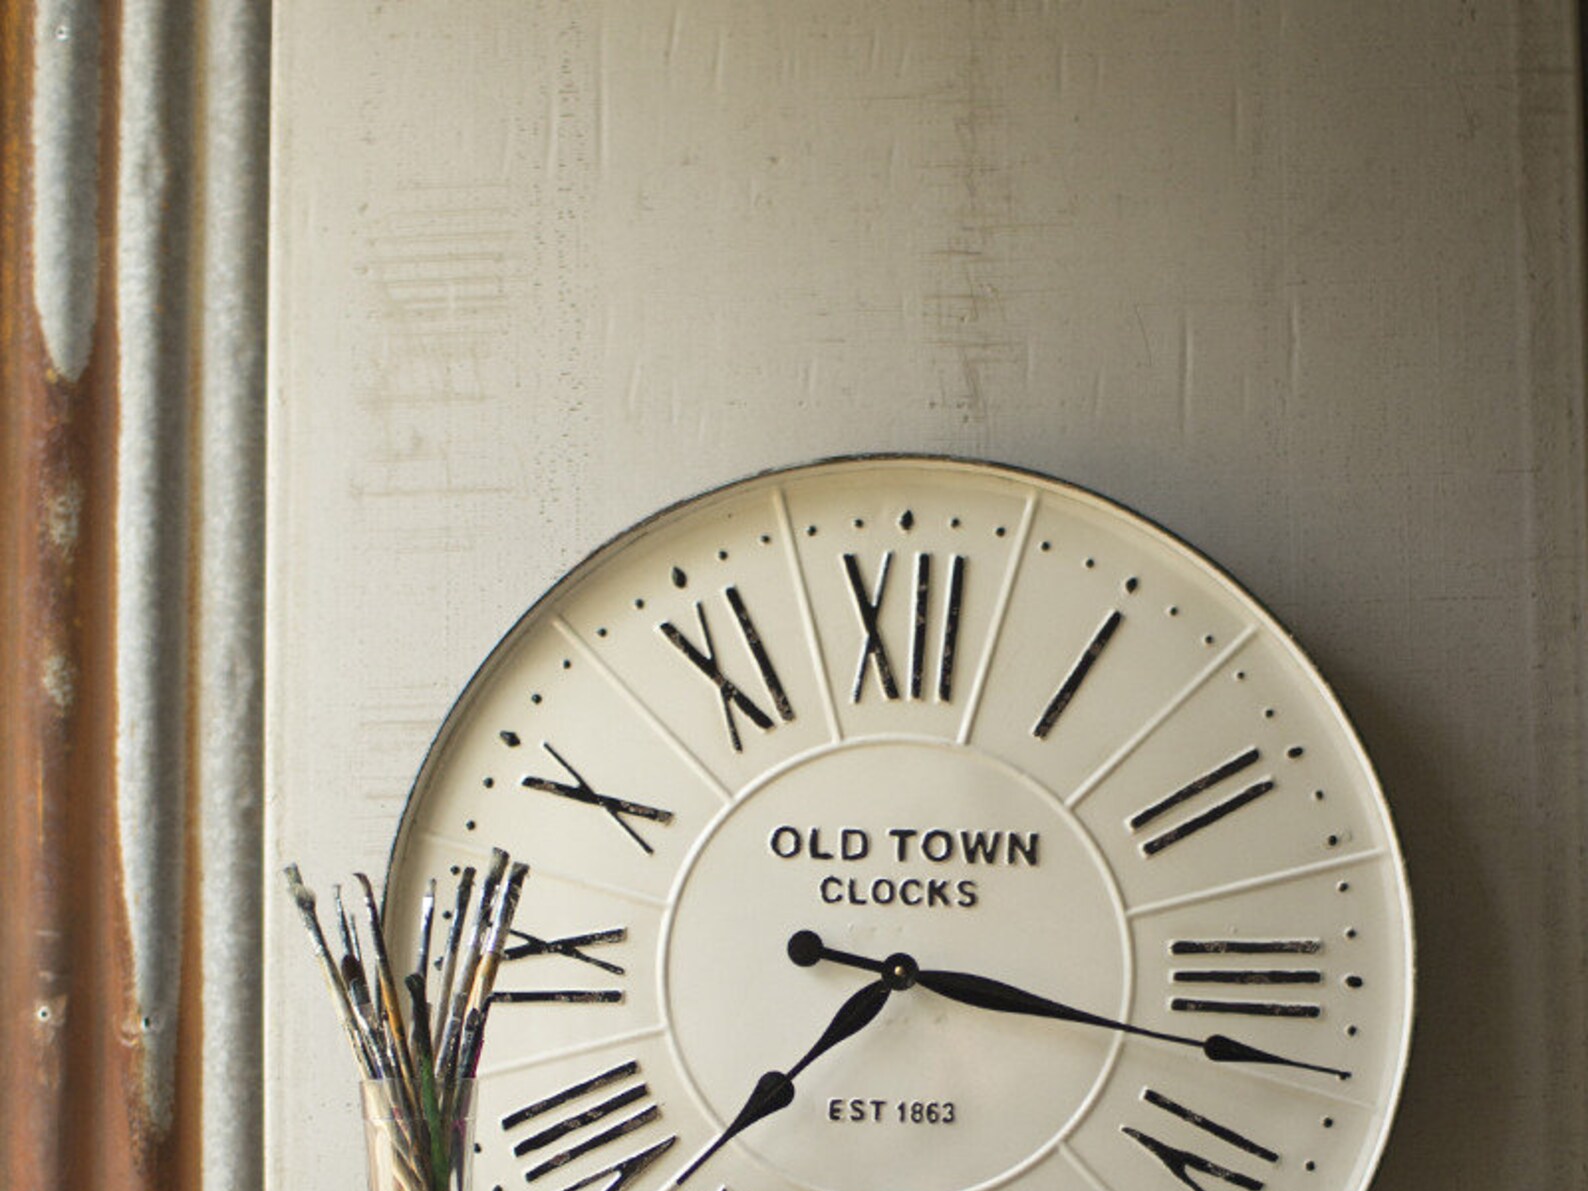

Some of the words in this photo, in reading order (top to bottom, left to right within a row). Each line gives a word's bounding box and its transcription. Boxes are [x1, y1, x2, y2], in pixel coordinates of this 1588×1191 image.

[660, 586, 795, 752] XI
[843, 551, 965, 703] XII
[1034, 610, 1122, 738] I
[521, 742, 674, 854] X
[1130, 748, 1274, 856] II
[770, 825, 868, 861] OLD
[889, 829, 1039, 866] TOWN
[820, 876, 979, 907] CLOCKS
[491, 928, 627, 1003] IX
[1171, 940, 1321, 1017] III
[829, 1100, 886, 1121] EST
[896, 1102, 956, 1123] 1863
